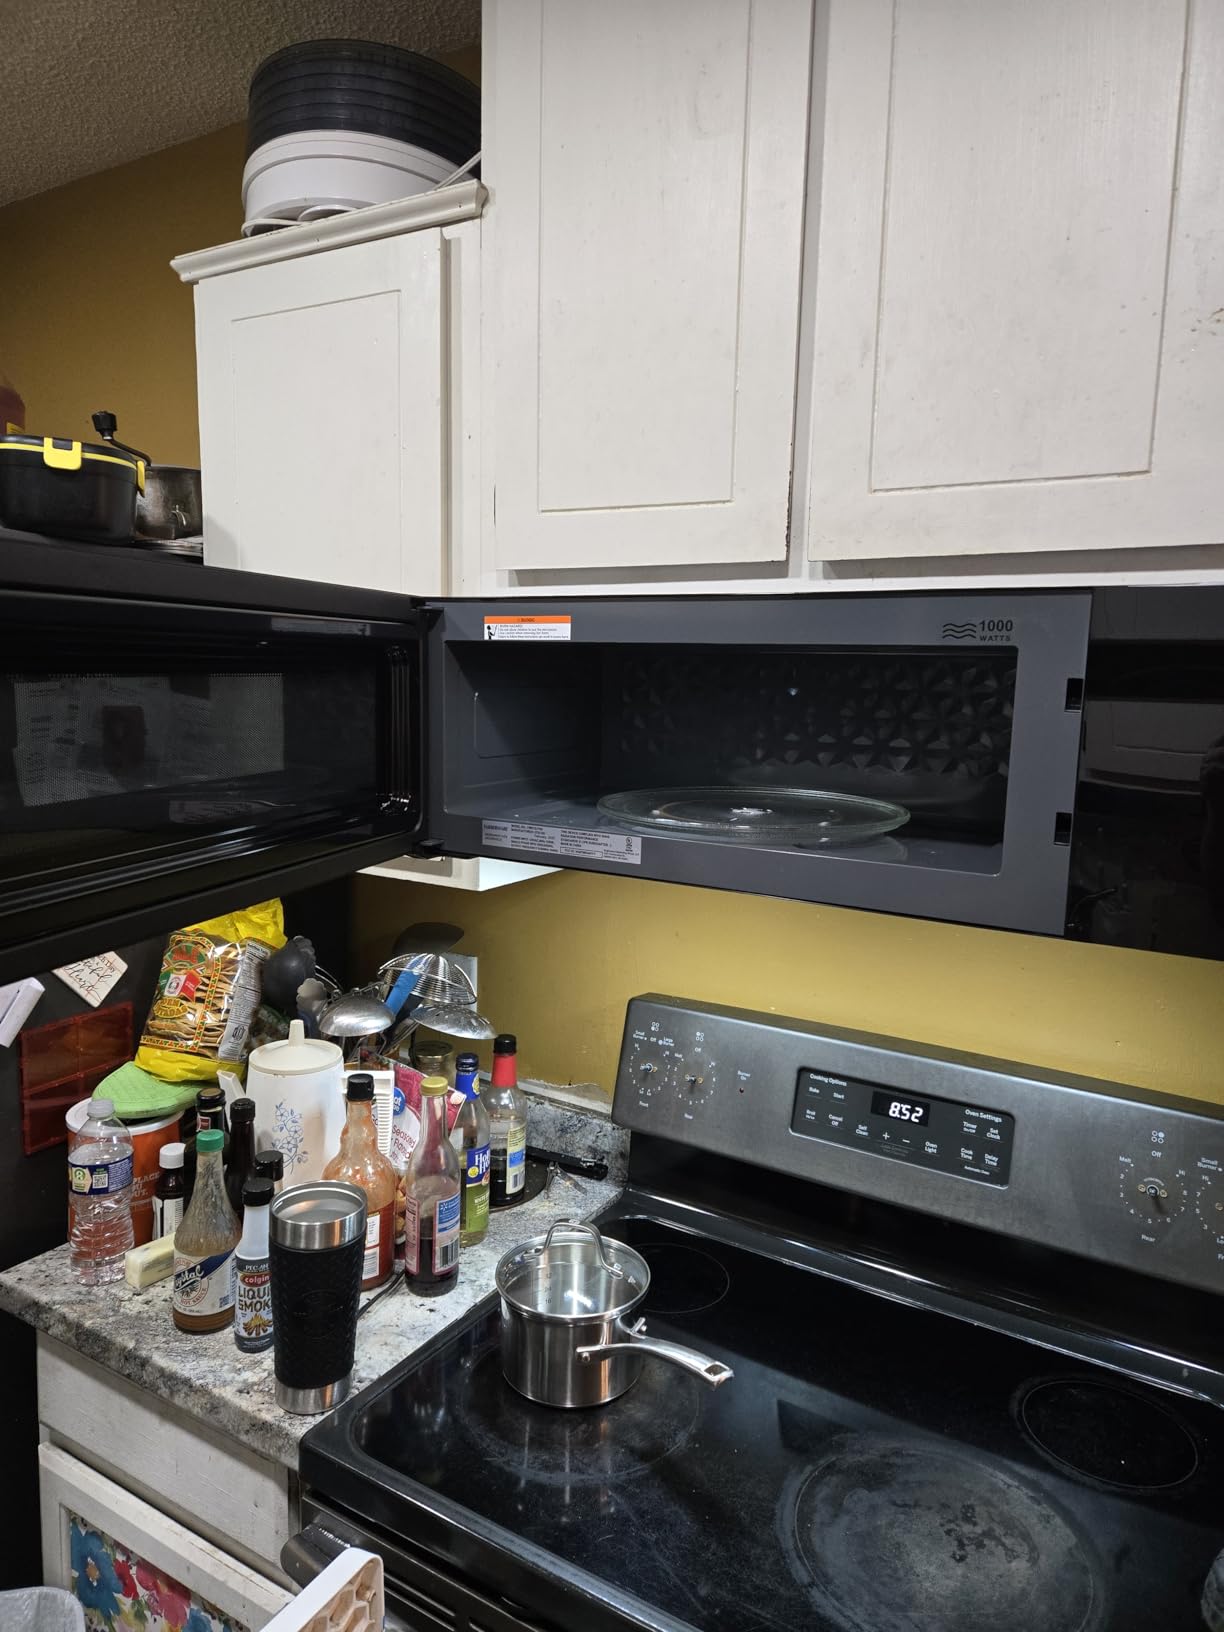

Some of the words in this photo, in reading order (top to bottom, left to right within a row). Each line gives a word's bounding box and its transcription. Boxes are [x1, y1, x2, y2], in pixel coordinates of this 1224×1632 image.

[979, 620, 1013, 632] 1000
[810, 1073, 829, 1084] Cooking
[828, 1077, 848, 1087] Options
[965, 1108, 979, 1118] Oven
[979, 1112, 1003, 1123] Settings
[1151, 1150, 1162, 1158] Off
[244, 1275, 270, 1285] colgin
[238, 1285, 271, 1300] LIQUI
[238, 1298, 271, 1313] SMOK
